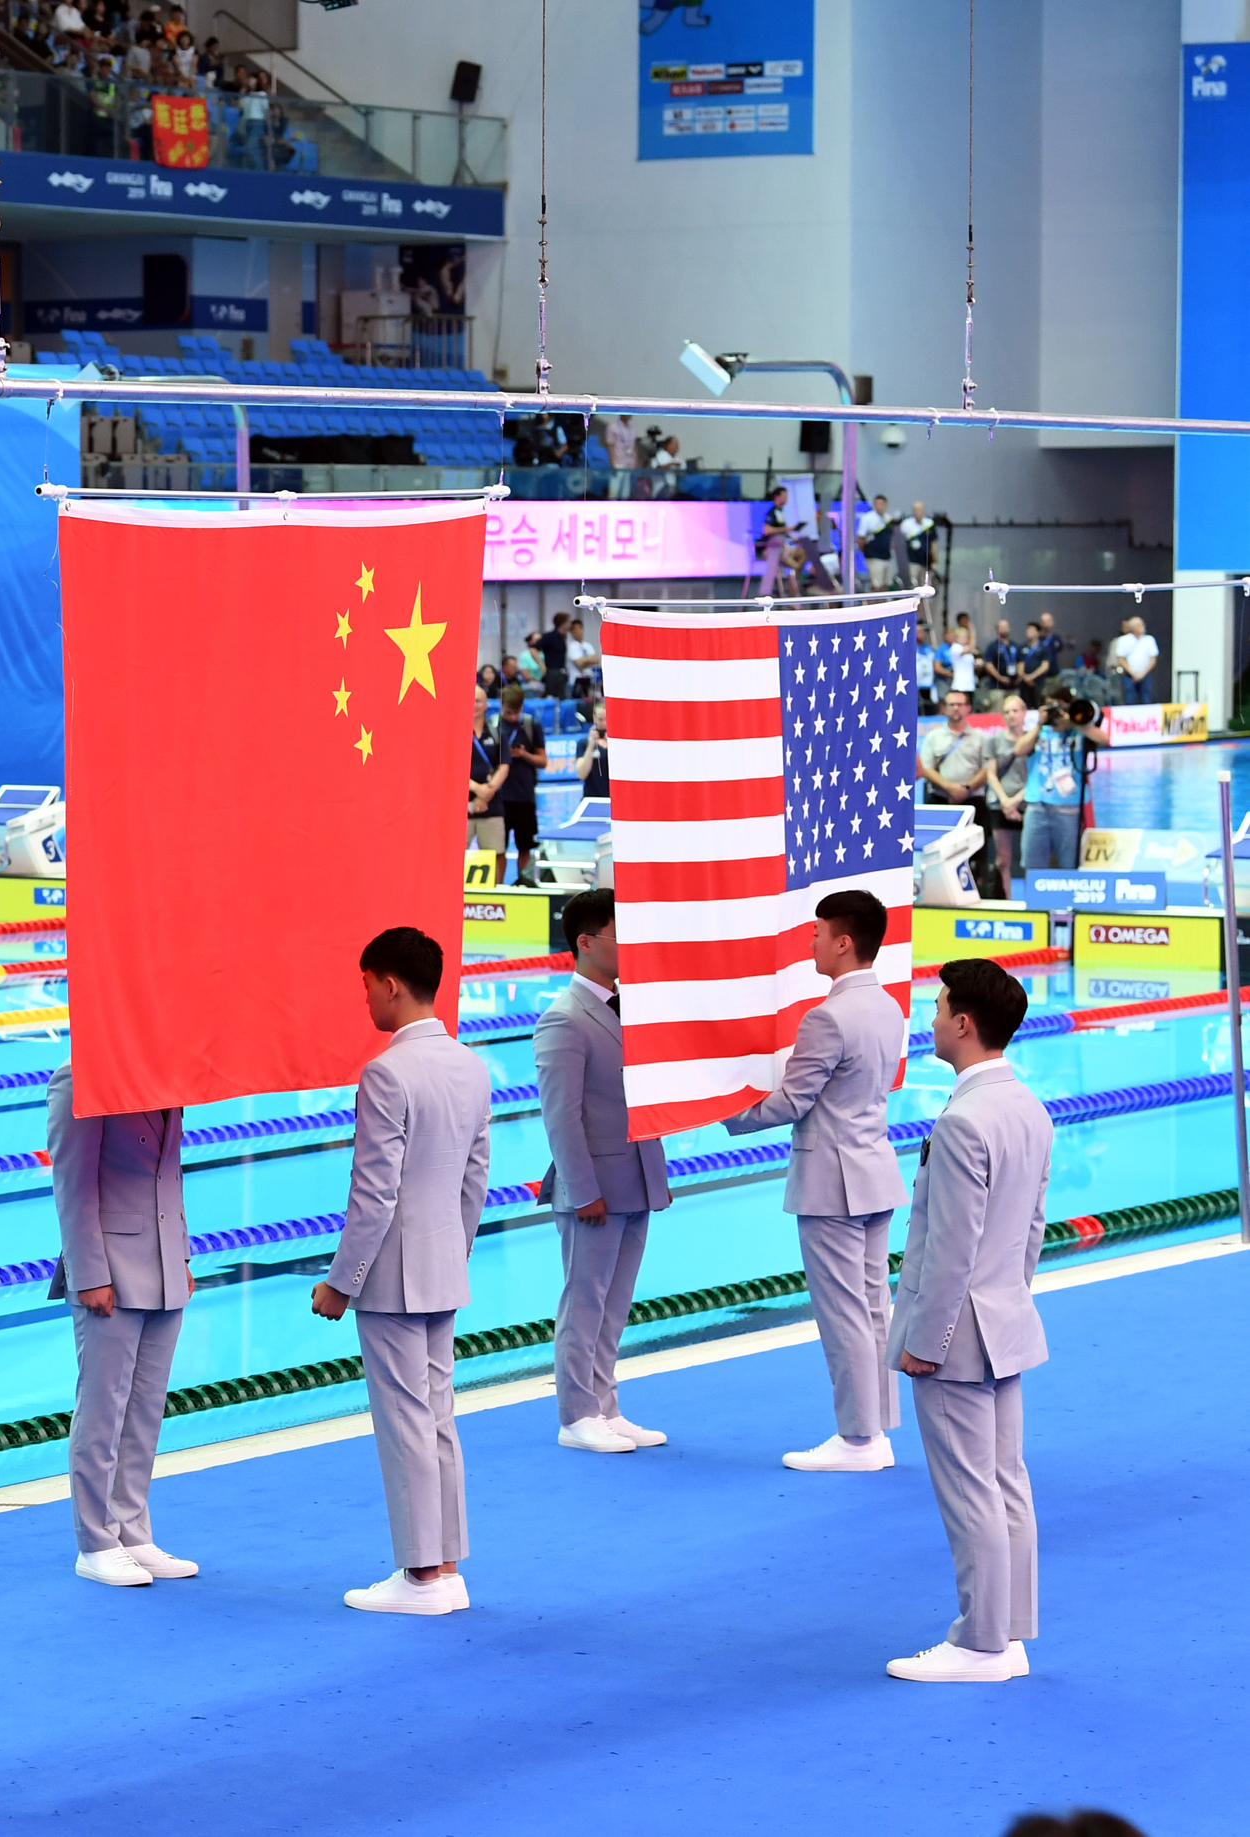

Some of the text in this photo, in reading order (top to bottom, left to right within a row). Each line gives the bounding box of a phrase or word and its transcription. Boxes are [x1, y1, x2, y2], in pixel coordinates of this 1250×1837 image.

[1113, 717, 1159, 734] Yakult
[1162, 710, 1206, 736] Nikon
[46, 840, 56, 861] 3
[1034, 878, 1106, 892] GWANGJU
[1115, 878, 1156, 901] Fina
[1073, 891, 1106, 904] 2019
[464, 904, 506, 920] MEGA
[993, 920, 1023, 940] Fina
[1108, 926, 1170, 946] OMEGA
